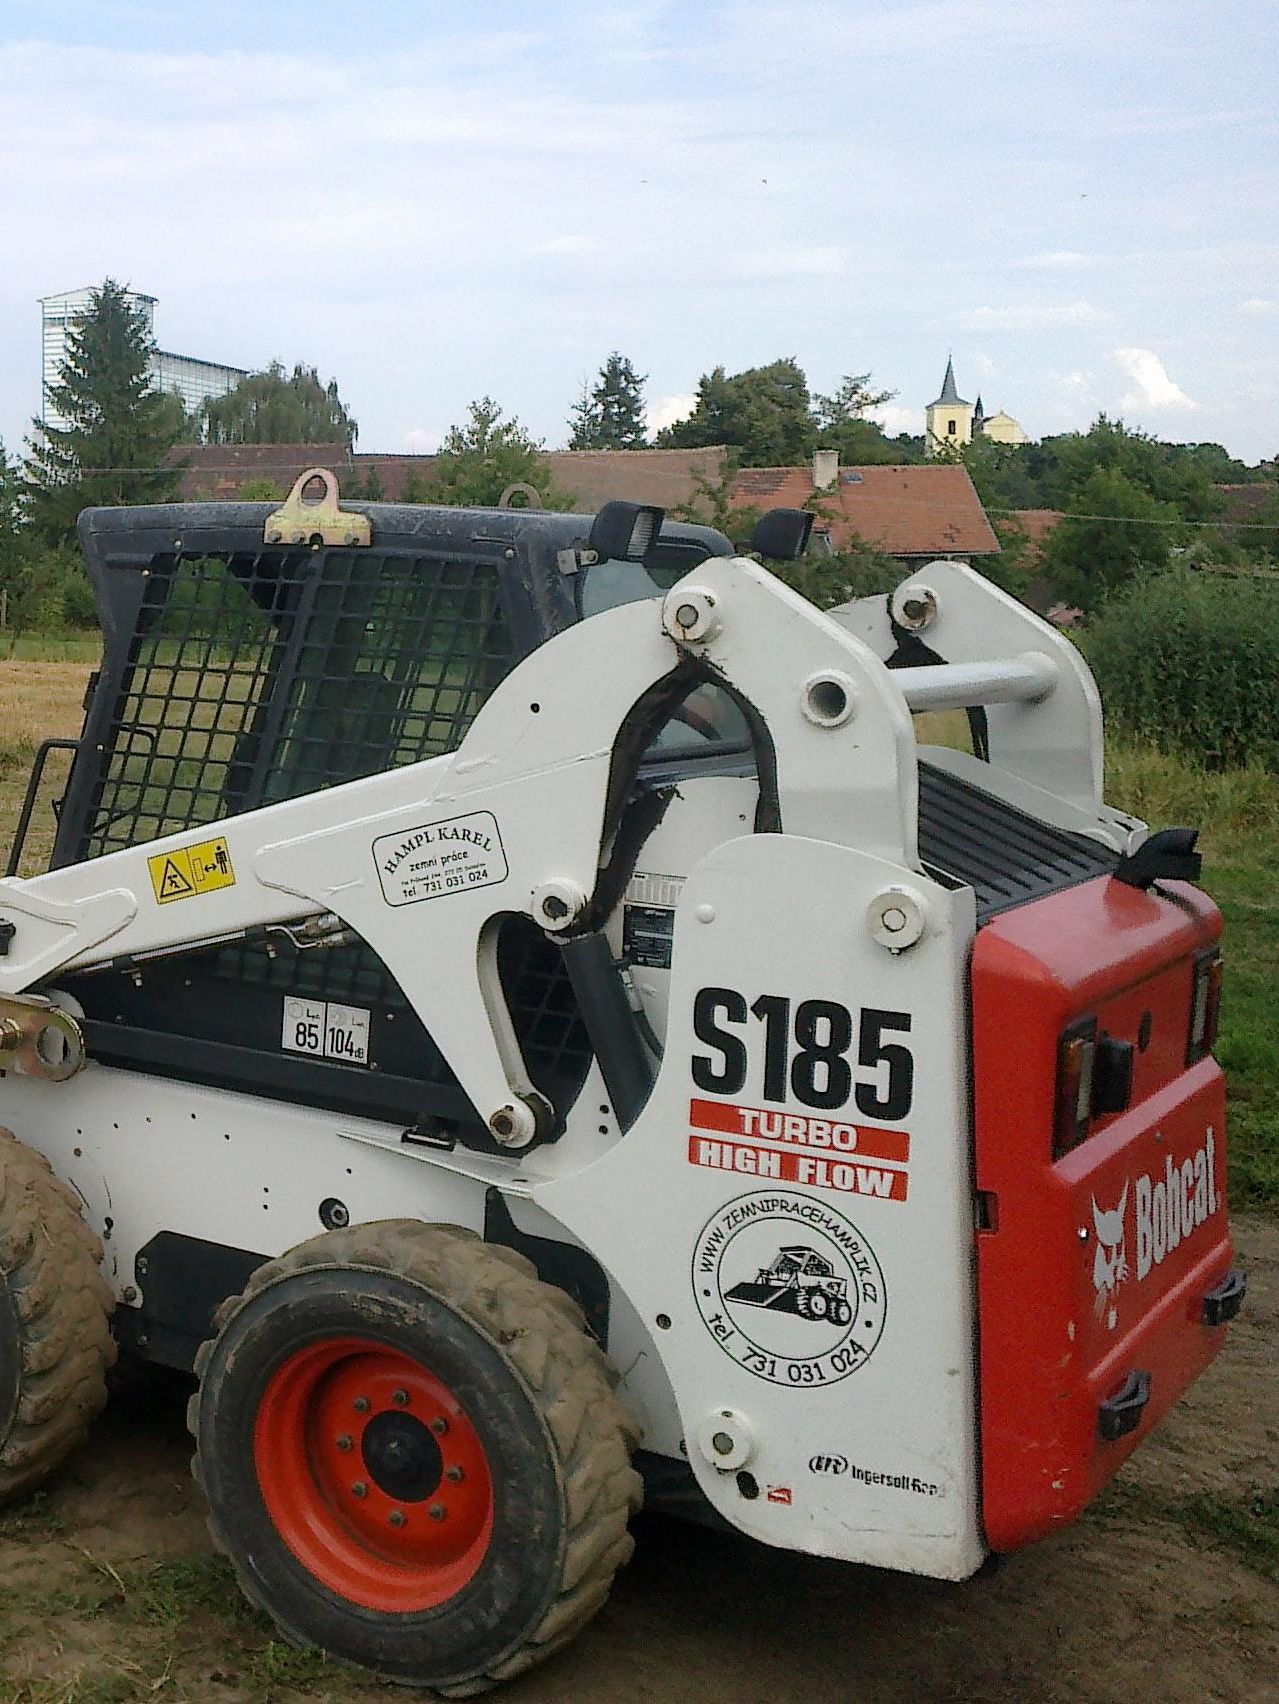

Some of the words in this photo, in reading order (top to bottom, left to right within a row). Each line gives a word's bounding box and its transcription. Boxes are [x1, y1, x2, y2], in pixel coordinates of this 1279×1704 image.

[384, 831, 434, 874] HAMPL
[437, 827, 492, 852] KAREL
[423, 880, 442, 893] 731
[446, 875, 465, 888] 031
[468, 869, 488, 883] 024
[295, 1022, 319, 1050] 85
[329, 1027, 354, 1057] 104
[691, 986, 914, 1121] S185
[738, 1108, 858, 1151] TURBO
[698, 1139, 781, 1180] HIGH
[797, 1158, 895, 1199] FLOW
[1135, 1124, 1217, 1282] Bobcat
[742, 1346, 777, 1377] 731
[787, 1362, 826, 1382] 031
[830, 1338, 869, 1373] 024
[852, 1464, 909, 1491] Ingersoll
